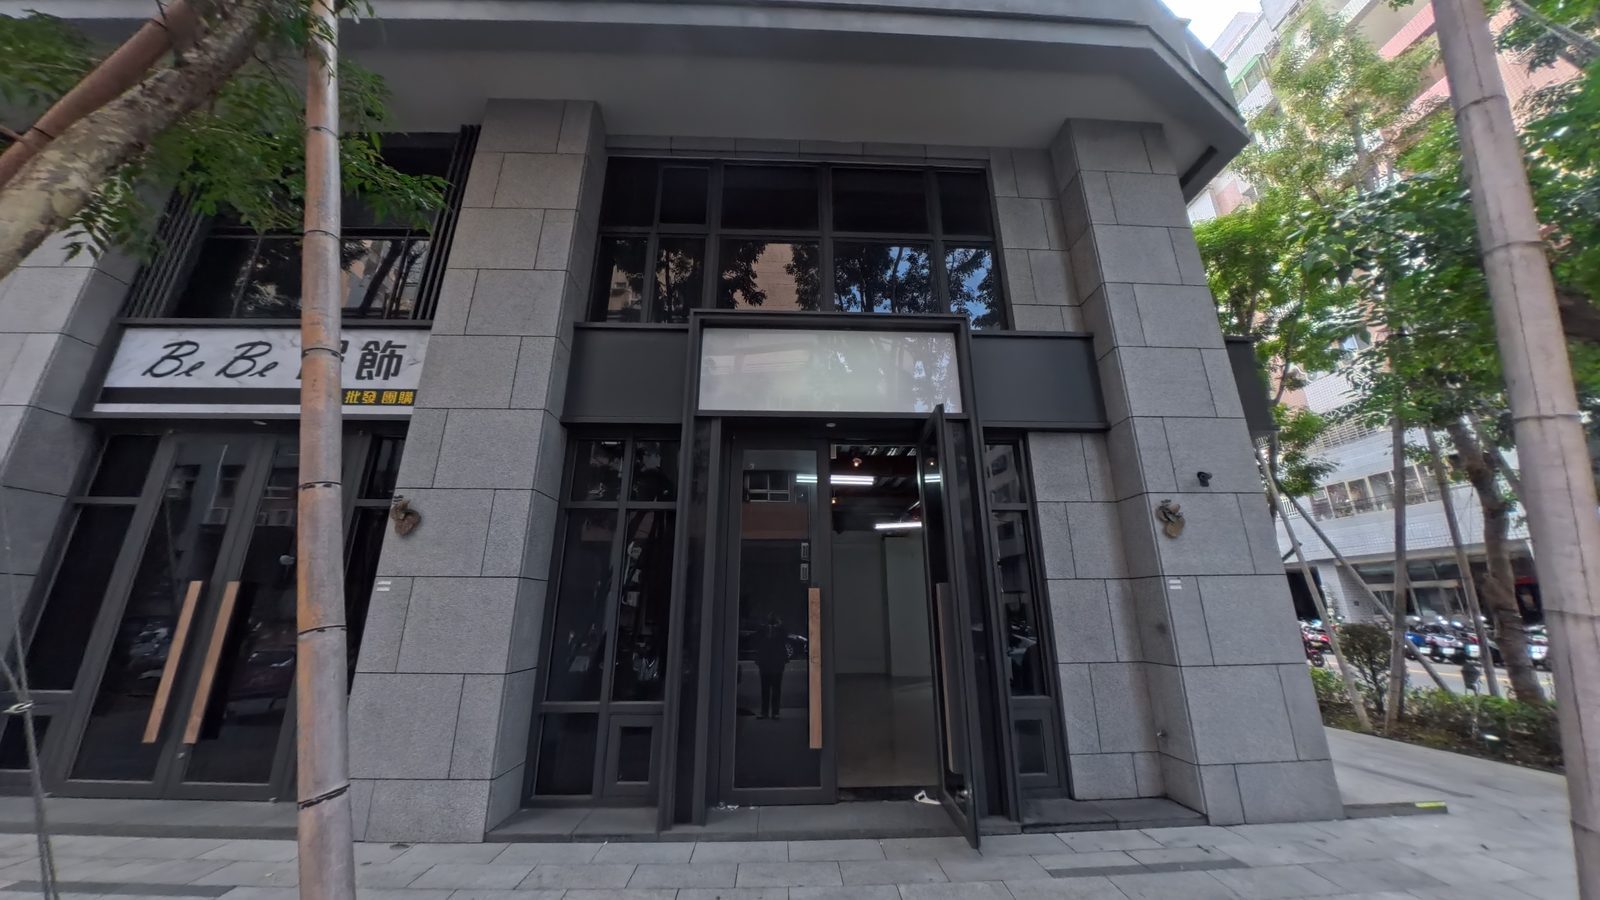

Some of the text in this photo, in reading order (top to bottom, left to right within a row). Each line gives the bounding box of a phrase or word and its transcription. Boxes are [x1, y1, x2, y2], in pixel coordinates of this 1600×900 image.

[141, 340, 407, 380] Be Be 飾
[345, 390, 414, 405] 批發 團購
